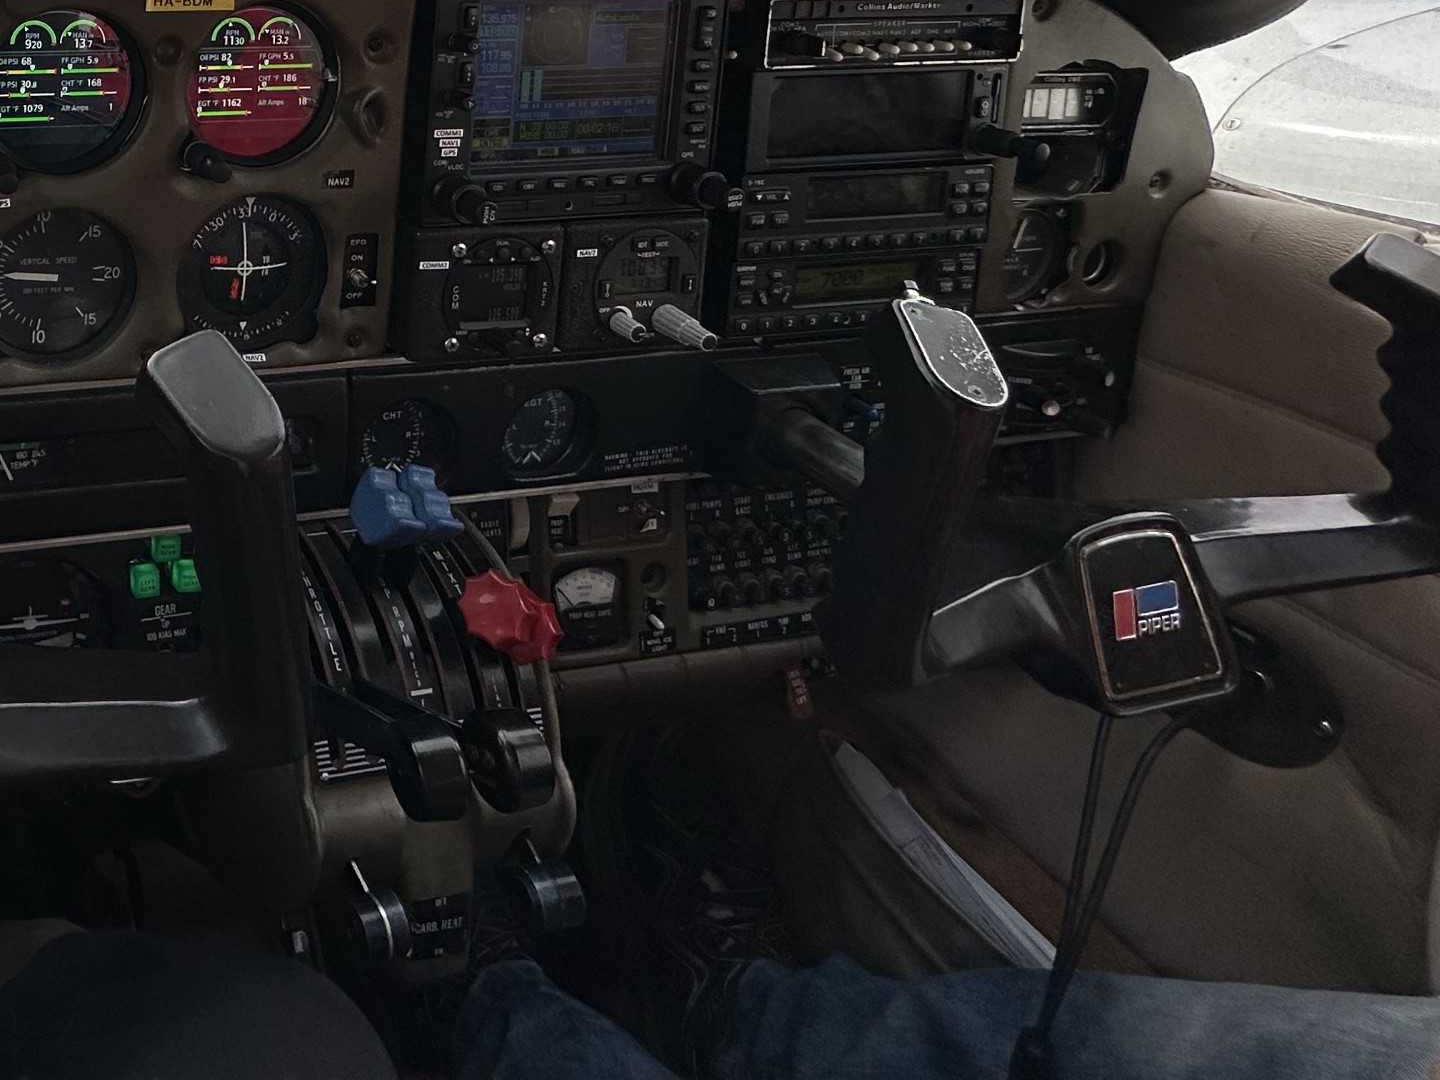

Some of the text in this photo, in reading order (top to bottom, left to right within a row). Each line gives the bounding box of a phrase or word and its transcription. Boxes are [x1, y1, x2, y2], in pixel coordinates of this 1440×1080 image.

[25, 40, 42, 49] 920
[74, 39, 93, 49] 13.7
[223, 36, 245, 46] 1130
[271, 35, 289, 45] 13.2
[21, 57, 32, 65] 68
[221, 53, 232, 61] 82
[283, 52, 294, 60] 5.5
[87, 78, 102, 87] 168
[220, 75, 236, 83] 29.1
[283, 74, 297, 82] 186
[327, 176, 350, 187] NAV2
[87, 225, 101, 238] 15
[19, 256, 78, 266] VERTICAL SPEED
[351, 254, 364, 262] ON
[104, 267, 120, 279] 20
[346, 291, 363, 300] OFF
[635, 299, 653, 309] NAV
[83, 313, 96, 325] 15
[31, 330, 46, 344] 10
[383, 411, 402, 421] CHT
[155, 603, 176, 616] GEAR
[301, 570, 342, 672] HROTTLE
[1137, 612, 1181, 637] PIPER
[173, 628, 187, 637] MAX
[441, 917, 463, 929] HEAT
